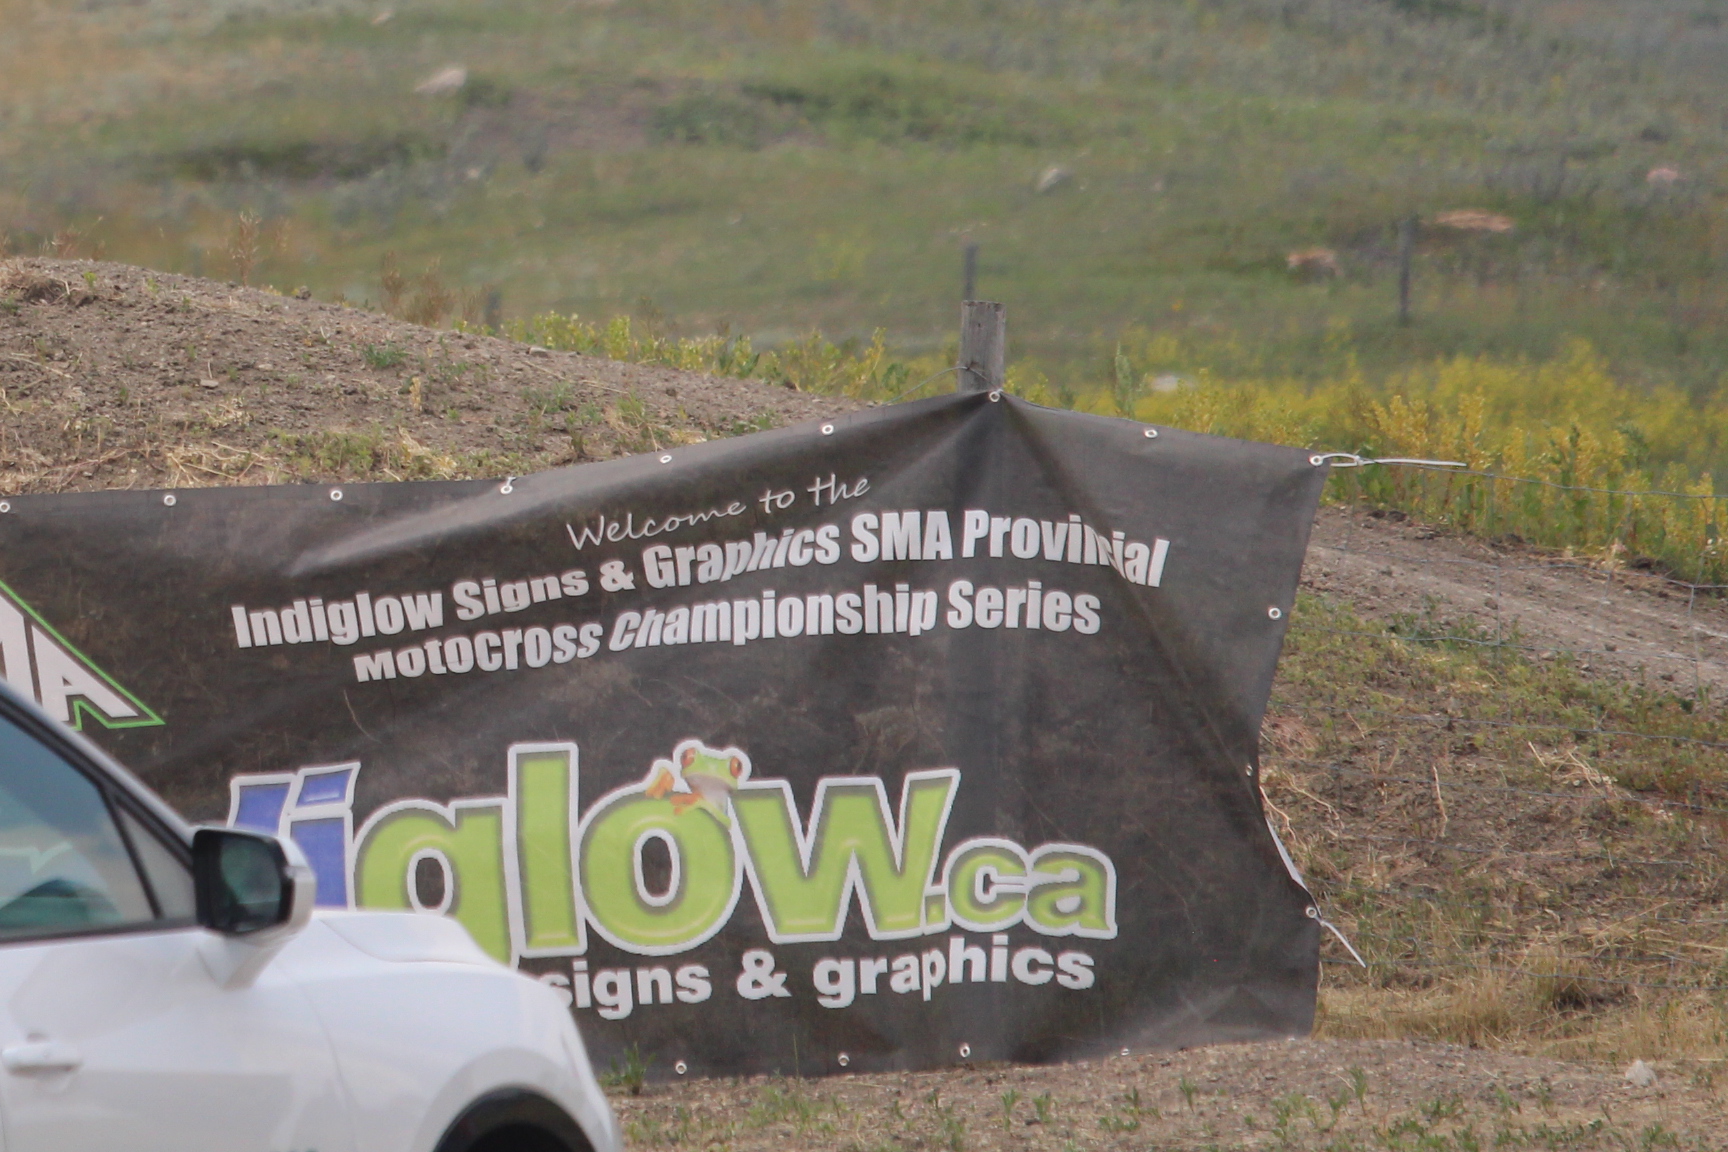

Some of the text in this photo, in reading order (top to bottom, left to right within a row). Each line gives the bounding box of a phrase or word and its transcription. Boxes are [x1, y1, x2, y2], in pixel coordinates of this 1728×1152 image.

[566, 473, 871, 551] Welcome to the
[230, 592, 444, 649] Indiglow
[452, 569, 590, 621] Signs
[599, 559, 636, 593] &
[641, 523, 841, 590] Graphics
[850, 509, 954, 564] SMA
[607, 583, 939, 654] Championship
[945, 579, 1102, 637] Series
[736, 949, 791, 1001] &
[813, 932, 1098, 1010] graphics
